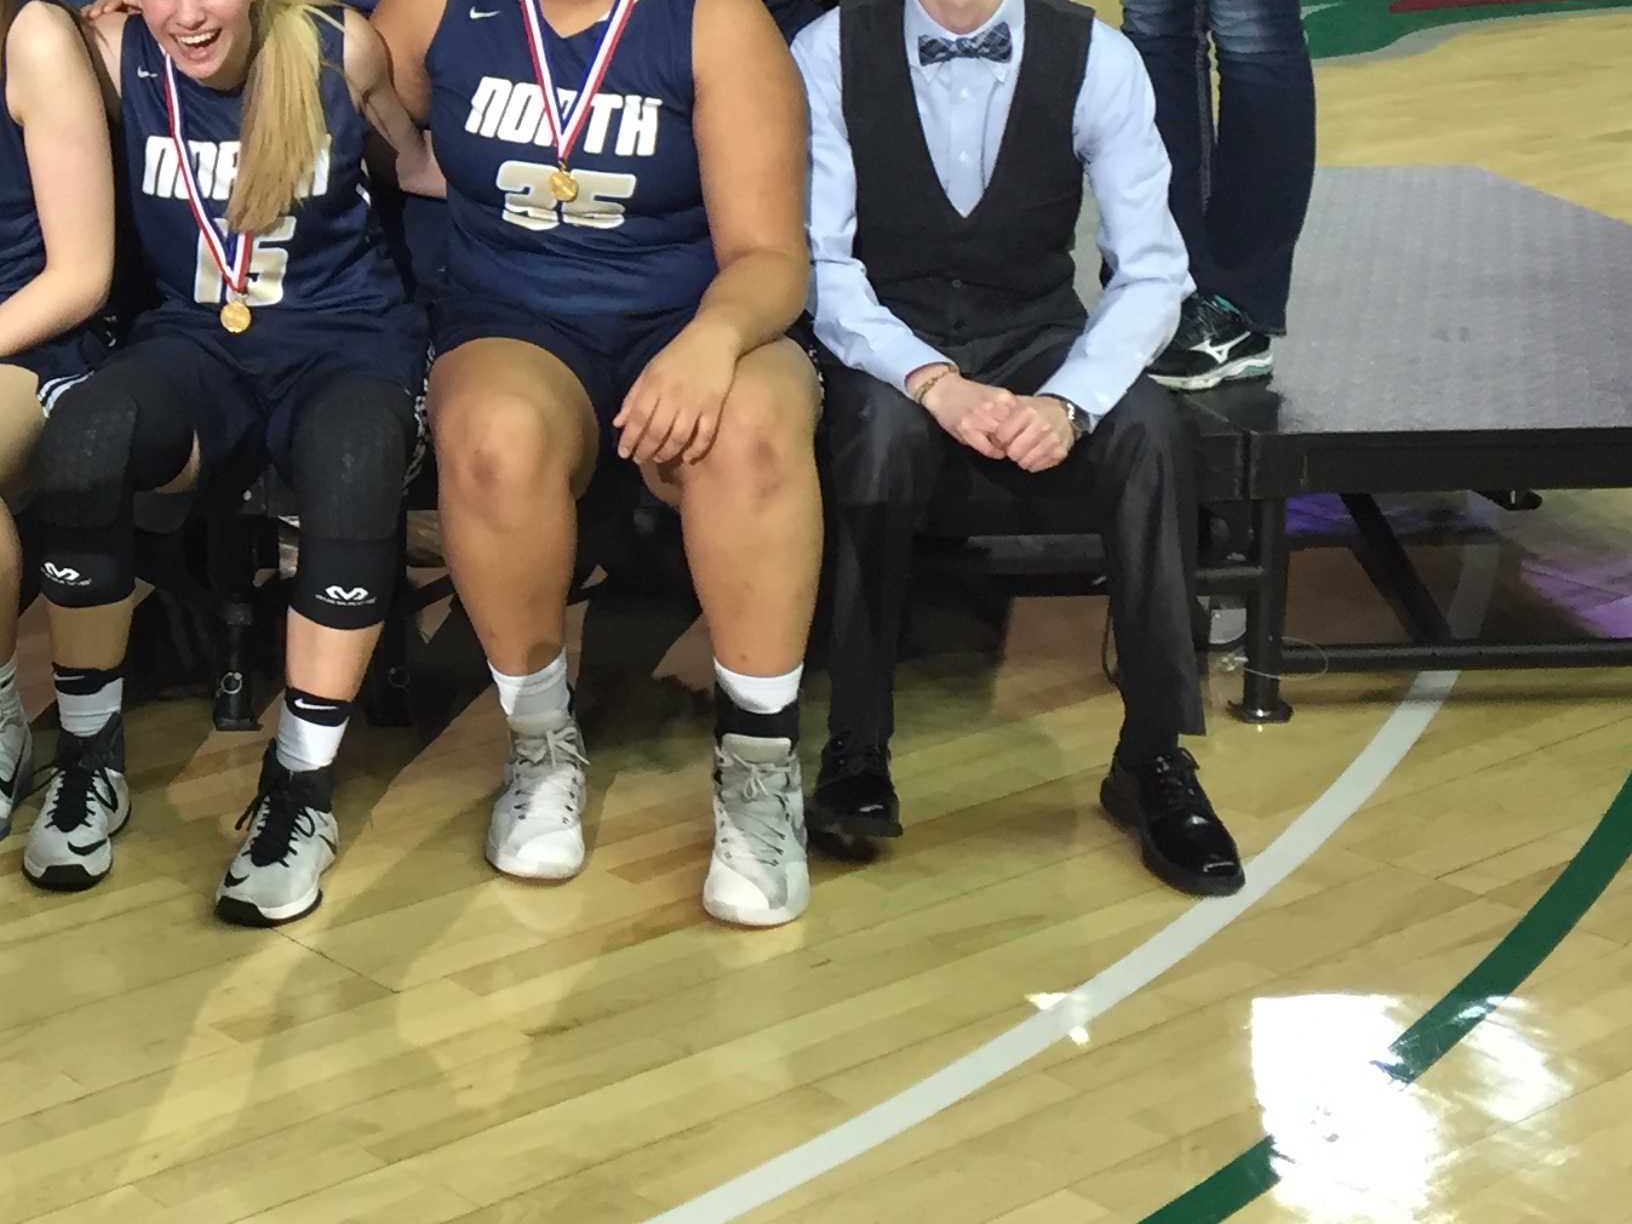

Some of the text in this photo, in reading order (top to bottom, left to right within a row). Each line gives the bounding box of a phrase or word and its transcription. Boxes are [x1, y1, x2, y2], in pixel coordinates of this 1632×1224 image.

[464, 76, 663, 157] NORTH
[142, 134, 333, 201] NORH
[495, 160, 637, 231] 35
[193, 215, 298, 308] 15
